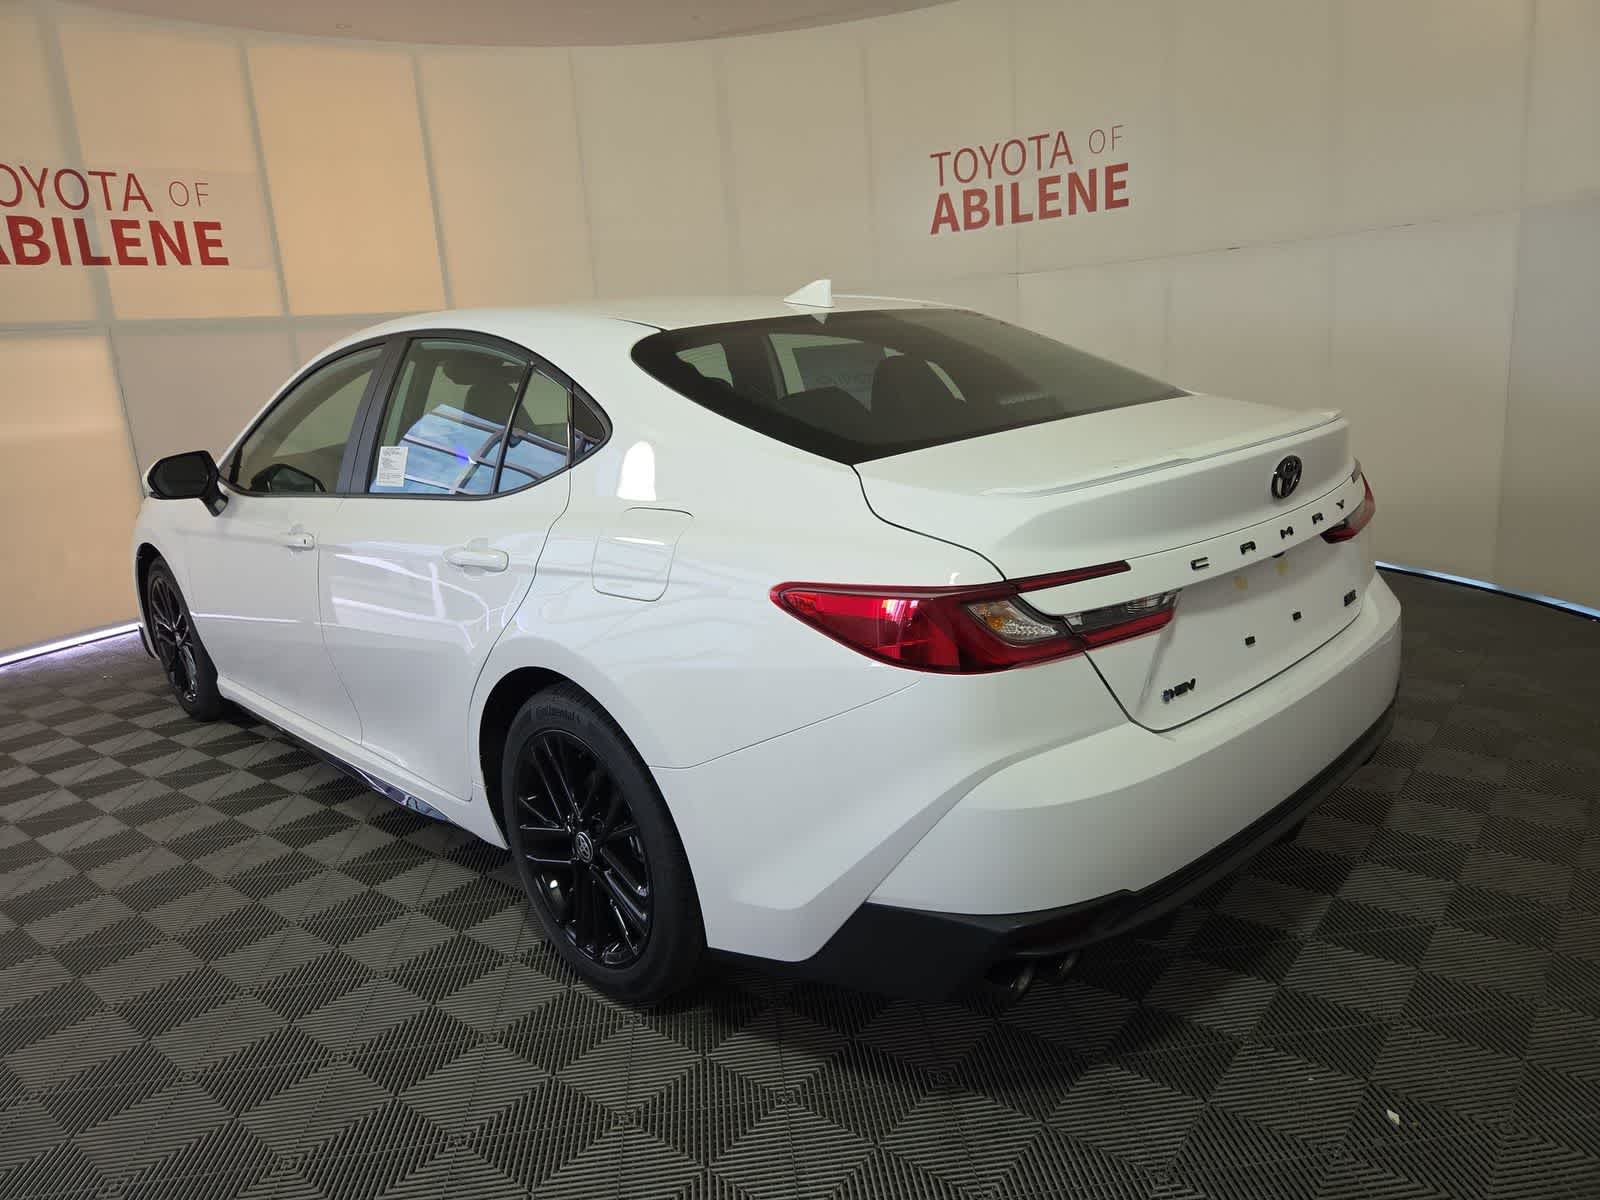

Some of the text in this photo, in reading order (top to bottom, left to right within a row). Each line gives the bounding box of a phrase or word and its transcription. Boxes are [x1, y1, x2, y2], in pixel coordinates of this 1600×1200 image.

[930, 125, 1124, 186] TOYOTA OF
[0, 163, 209, 212] OYOTA OF
[930, 162, 1129, 235] ABILENE
[0, 215, 230, 266] BILENE
[1190, 499, 1345, 571] CAMRY
